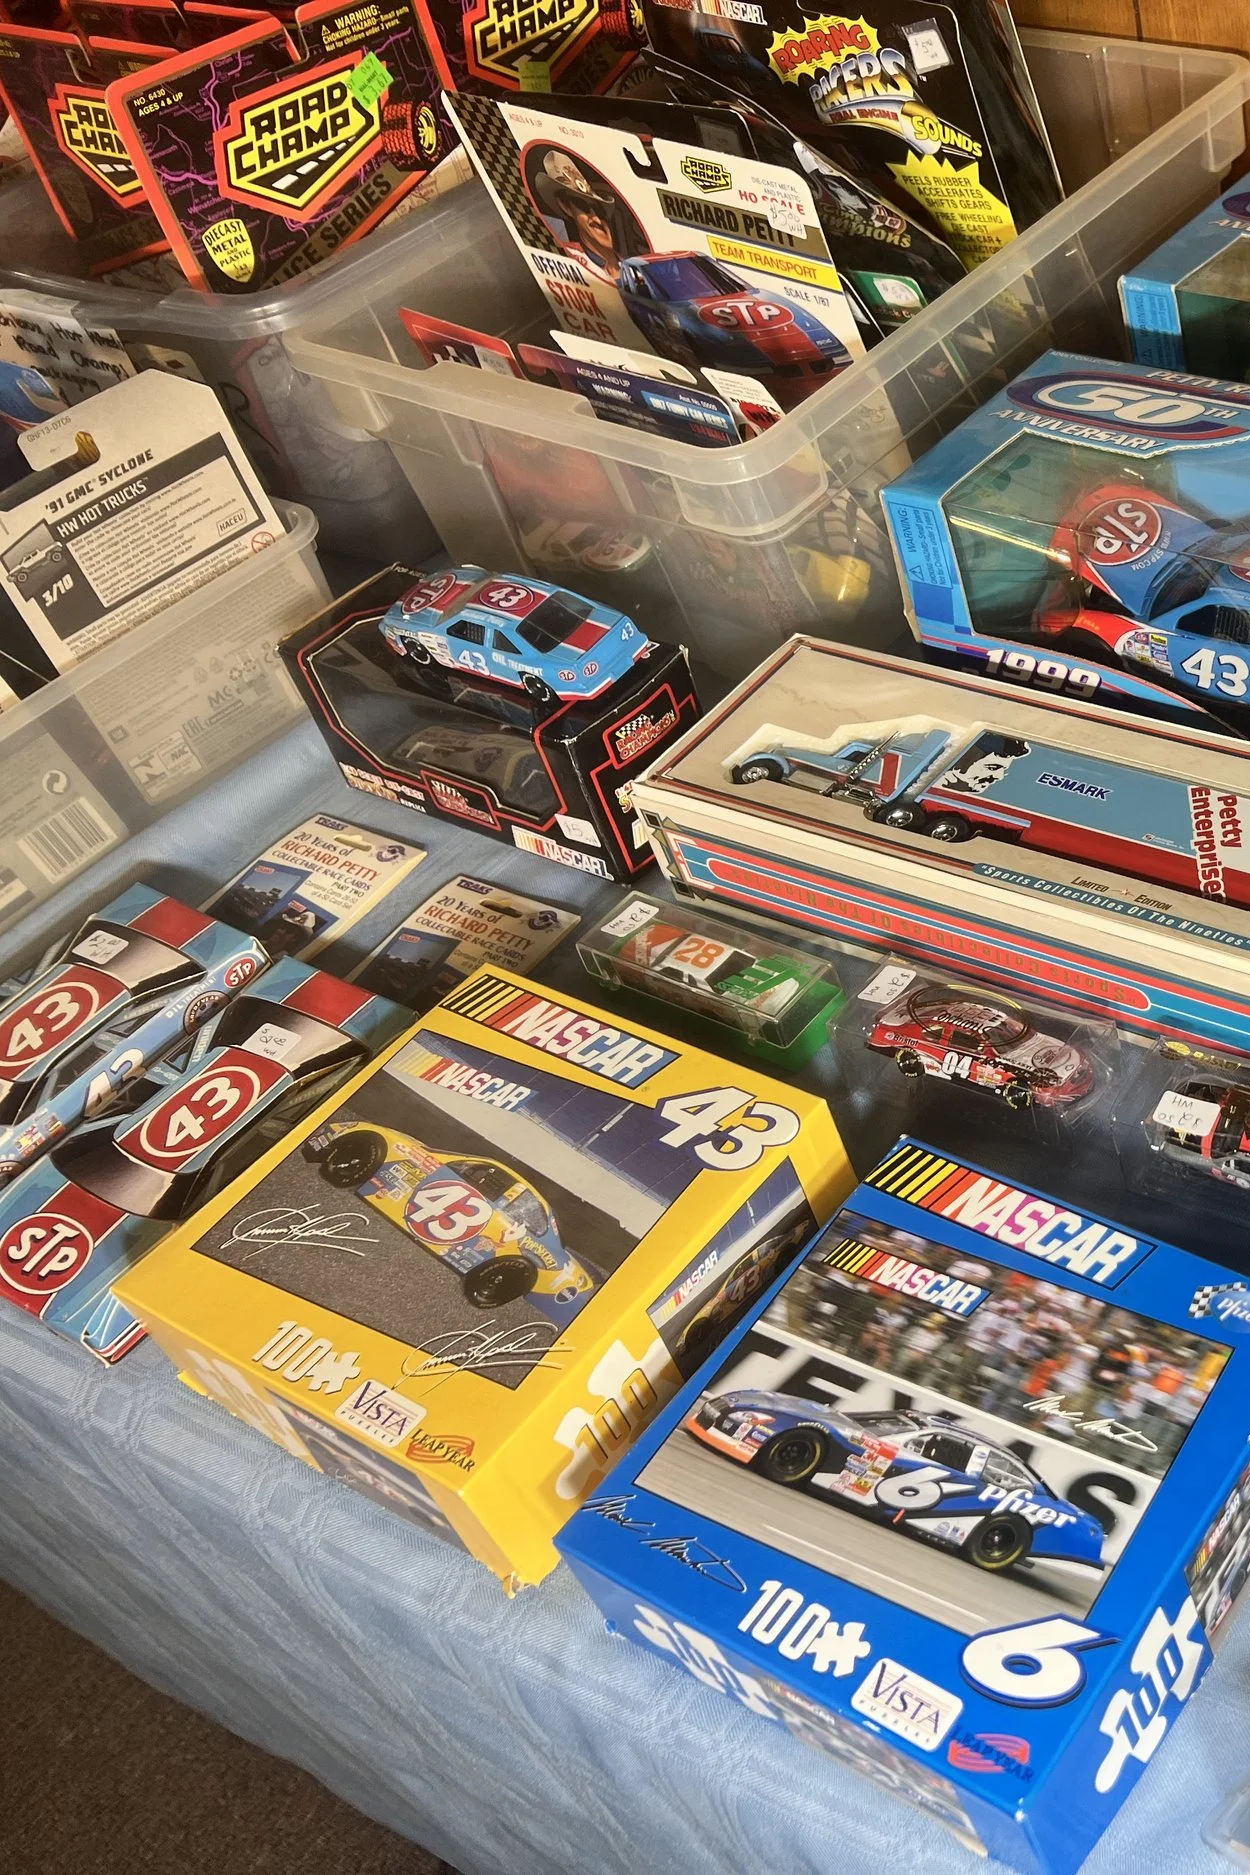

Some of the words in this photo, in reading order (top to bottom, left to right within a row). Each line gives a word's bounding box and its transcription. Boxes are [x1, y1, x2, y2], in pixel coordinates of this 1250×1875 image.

[335, 5, 380, 29] WARNING:
[719, 0, 764, 24] NASCAR
[772, 22, 871, 73] ROARING
[148, 89, 166, 103] 6430
[809, 48, 914, 112] RACERS
[138, 104, 158, 118] AGES
[251, 81, 347, 141] ROAD
[911, 115, 983, 158] SOUNDS
[683, 166, 733, 184] CHAMPS
[688, 157, 724, 173] ROAD
[902, 174, 931, 187] PEELS
[932, 176, 972, 188] RUBBER
[320, 172, 393, 249] SERIES
[738, 189, 759, 205] HO
[916, 186, 984, 201] ACCELERATES
[926, 198, 958, 210] SHIFTS
[959, 199, 993, 211] GEARS
[204, 219, 242, 247] DIECAST
[665, 195, 740, 236] RICHARD
[961, 212, 1004, 225] WHEELING
[212, 234, 248, 256] METAL
[219, 249, 252, 268] PLASTIC
[713, 241, 746, 262] TEAM
[747, 249, 818, 281] TRANSPORT
[531, 252, 588, 287] OFFICIAL
[545, 278, 606, 321] STOCK
[711, 301, 781, 328] STP
[783, 285, 811, 303] SCALE
[812, 292, 830, 308] 1/87
[564, 311, 617, 343] CAR
[1146, 369, 1220, 391] PETTY
[989, 404, 1175, 452] ANNIVERSARY
[98, 448, 155, 488] SYCLONE
[57, 518, 79, 539] HW
[78, 505, 102, 528] HOT
[218, 512, 244, 532] HACEU
[41, 573, 74, 607] 3/10
[485, 584, 530, 610] 43
[620, 620, 637, 643] 43
[457, 648, 492, 676] 43
[491, 651, 509, 667] OIL
[508, 657, 545, 678] TREATMENT
[984, 648, 1102, 698] 1999
[1181, 647, 1250, 697] 43
[1037, 772, 1112, 801] ESMARK
[293, 831, 311, 844] 20
[1217, 792, 1244, 849] Petty
[271, 849, 325, 876] COLLECTABLE
[323, 868, 345, 884] RACE
[344, 874, 373, 891] CARDS
[280, 839, 341, 870] RICHARD
[335, 857, 382, 881] PETTY
[1032, 876, 1125, 915] Collectibles
[1127, 904, 1144, 918] Of
[1146, 909, 1176, 928] The
[424, 904, 487, 936] RICHARD
[488, 925, 536, 951] PETTY
[228, 958, 254, 987] STP
[672, 936, 726, 970] 28
[6, 990, 81, 1058] 43
[504, 1000, 664, 1085] NASCAR
[892, 1032, 920, 1047] Bristol
[941, 1051, 974, 1080] 04
[436, 1061, 534, 1111] NASCAR
[164, 1075, 242, 1149] 43
[656, 1086, 800, 1169] 43
[407, 1185, 493, 1241] 43
[940, 1175, 1140, 1288] NASCAR
[6, 1220, 81, 1282] STP
[868, 1257, 986, 1315] NASCAR
[252, 1320, 334, 1383] 100
[352, 1380, 409, 1437] VISTA
[411, 1427, 444, 1456] LEAP
[442, 1446, 477, 1473] YEAR
[979, 1482, 1077, 1529] Pfizer
[737, 1579, 832, 1662] 100
[960, 1614, 1121, 1707] 6
[871, 1661, 942, 1735] VISTA
